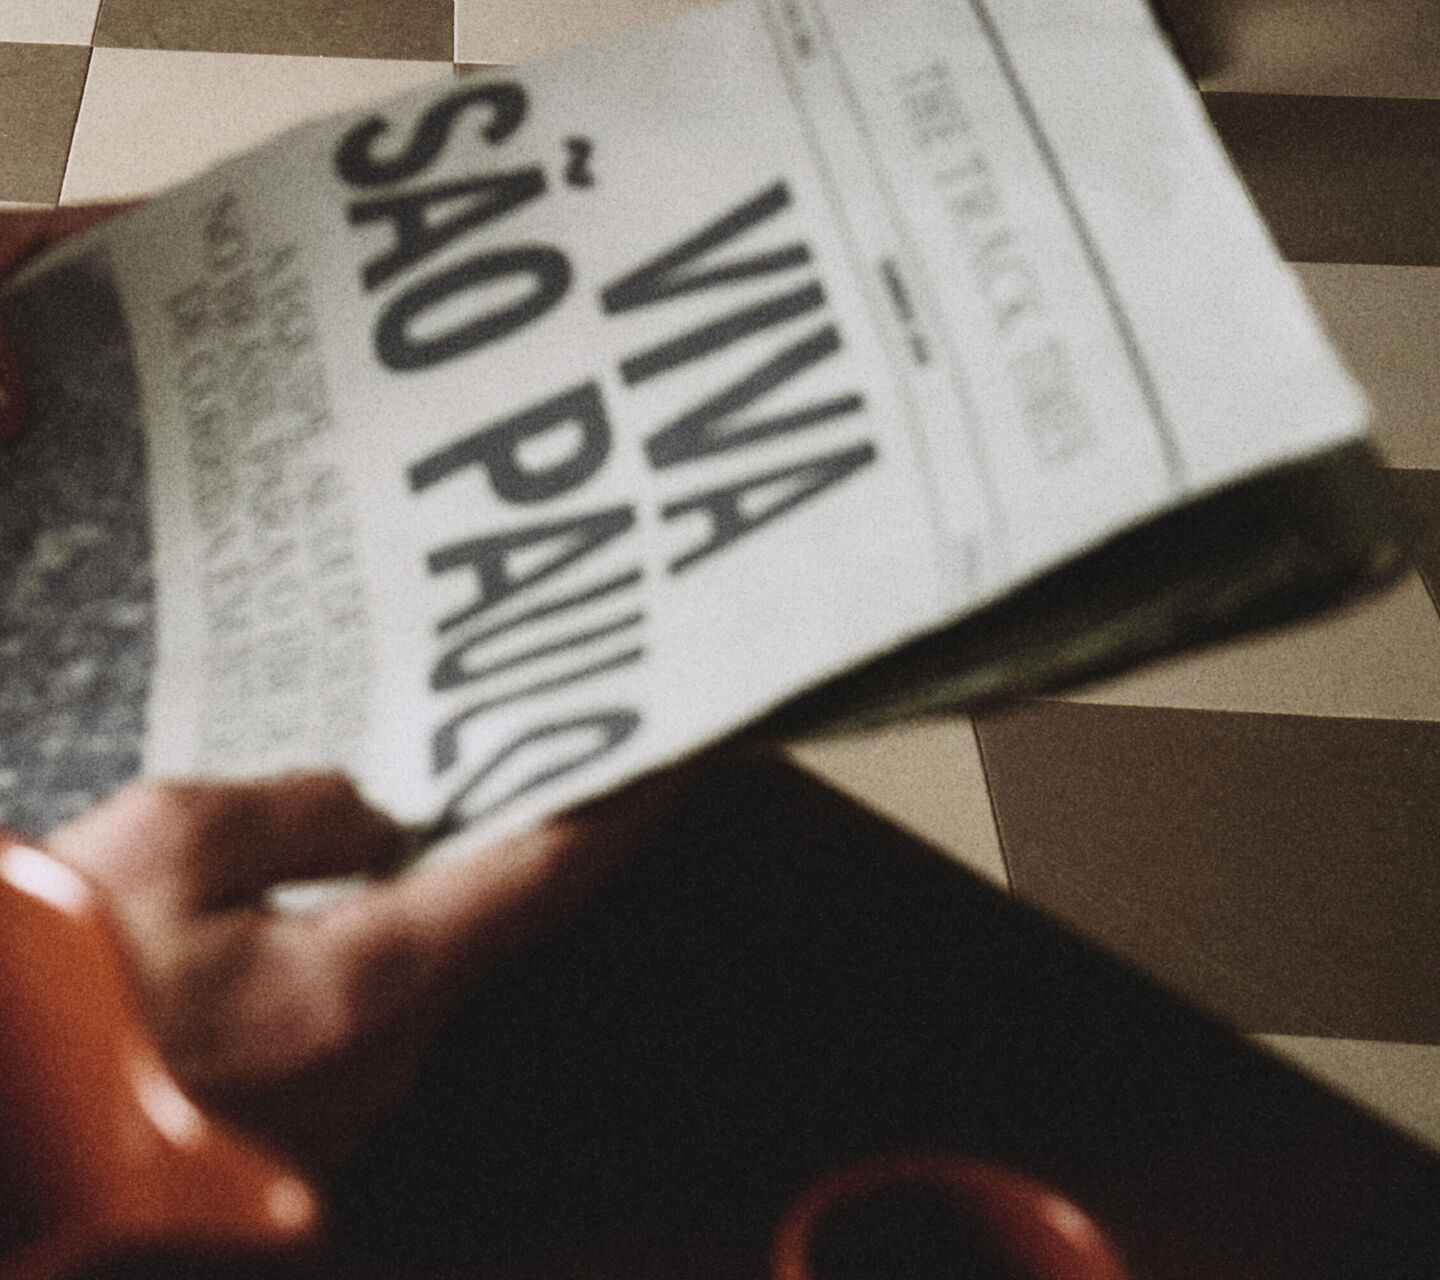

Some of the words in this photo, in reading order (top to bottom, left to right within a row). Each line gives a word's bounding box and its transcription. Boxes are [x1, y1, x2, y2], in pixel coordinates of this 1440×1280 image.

[333, 80, 595, 374] SÃO
[598, 178, 879, 577] VIVA
[406, 377, 646, 838] PAULO
